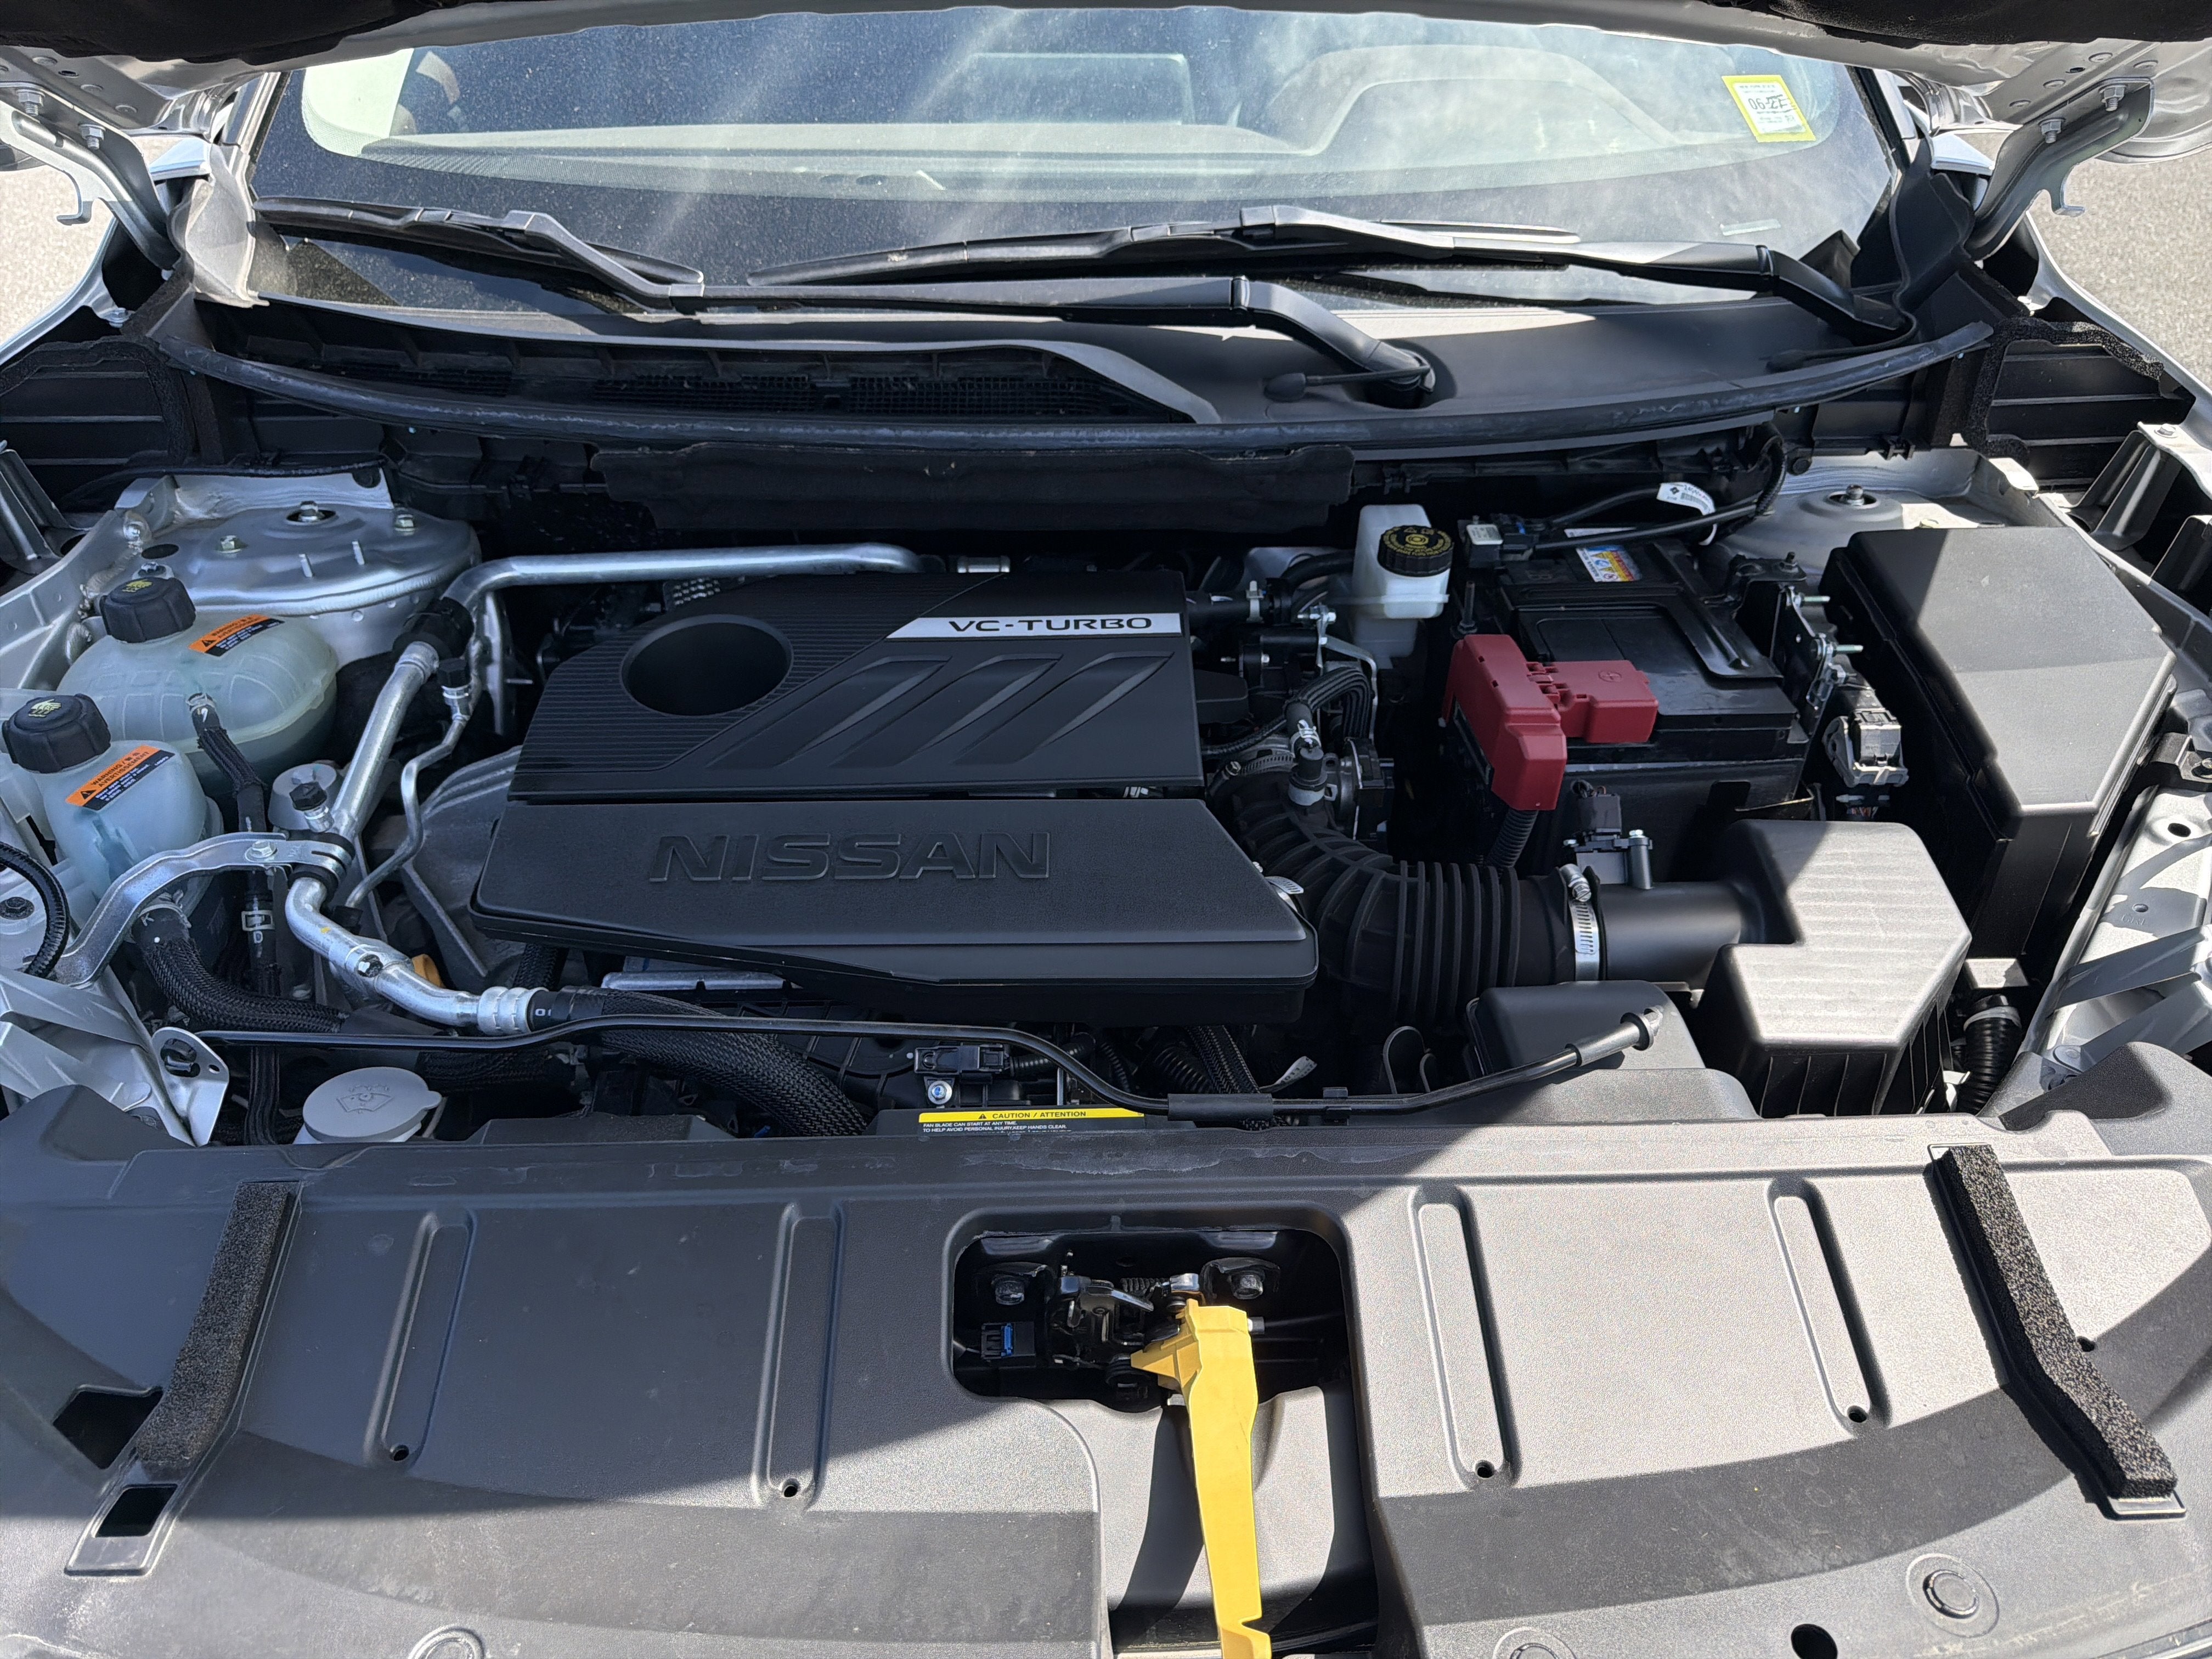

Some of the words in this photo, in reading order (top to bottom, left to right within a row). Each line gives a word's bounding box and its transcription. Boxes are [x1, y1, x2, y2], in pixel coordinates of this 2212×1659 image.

[949, 617, 1152, 632] VC-TURBO
[91, 764, 122, 785] WARNING
[650, 832, 1049, 881] NISSAN
